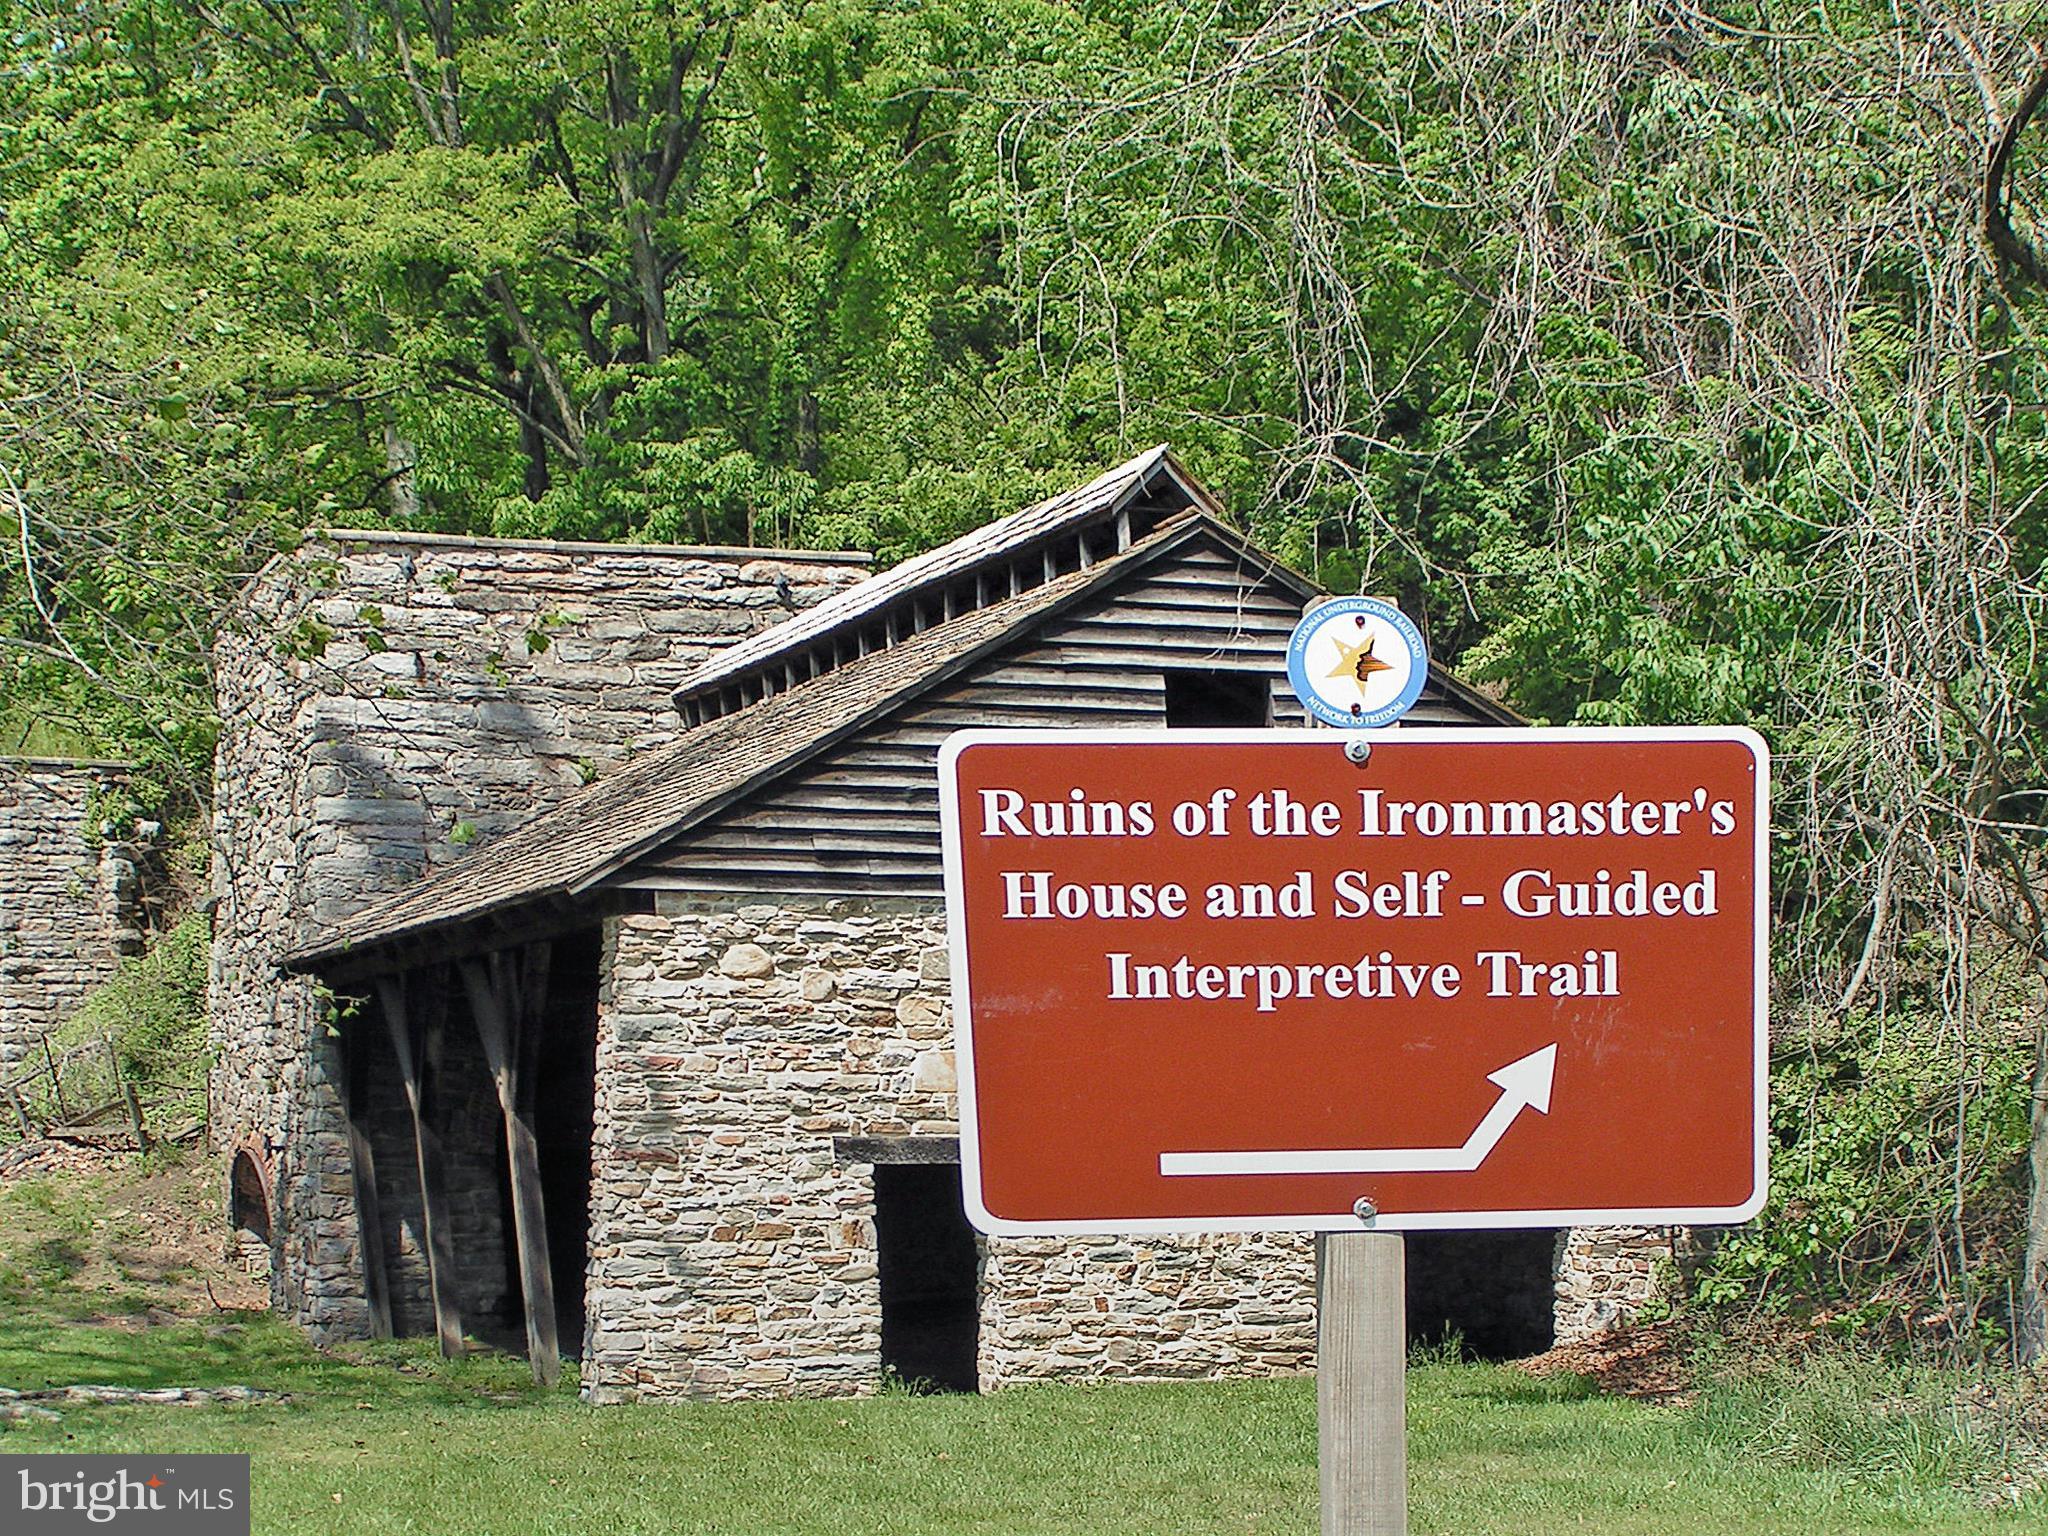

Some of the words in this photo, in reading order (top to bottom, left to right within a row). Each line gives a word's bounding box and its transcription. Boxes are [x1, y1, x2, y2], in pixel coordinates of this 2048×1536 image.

[1295, 613, 1323, 652] NATIONAL
[1323, 600, 1396, 620] UNDERGROUND
[1395, 615, 1422, 658] RAILROAD
[1307, 696, 1350, 724] NETWORK
[1351, 715, 1365, 725] TO
[1365, 701, 1406, 724] FREEDOM
[978, 789, 1154, 836] Ruins
[1173, 789, 1236, 836] of
[1248, 790, 1340, 836] the
[1358, 788, 1735, 835] Ironmaster's
[1000, 873, 1186, 918] House
[1206, 872, 1315, 917] and
[1335, 871, 1450, 917] Self
[1503, 870, 1718, 916] Guided
[1106, 952, 1459, 1011] Interpretive
[1478, 951, 1620, 996] Trail
